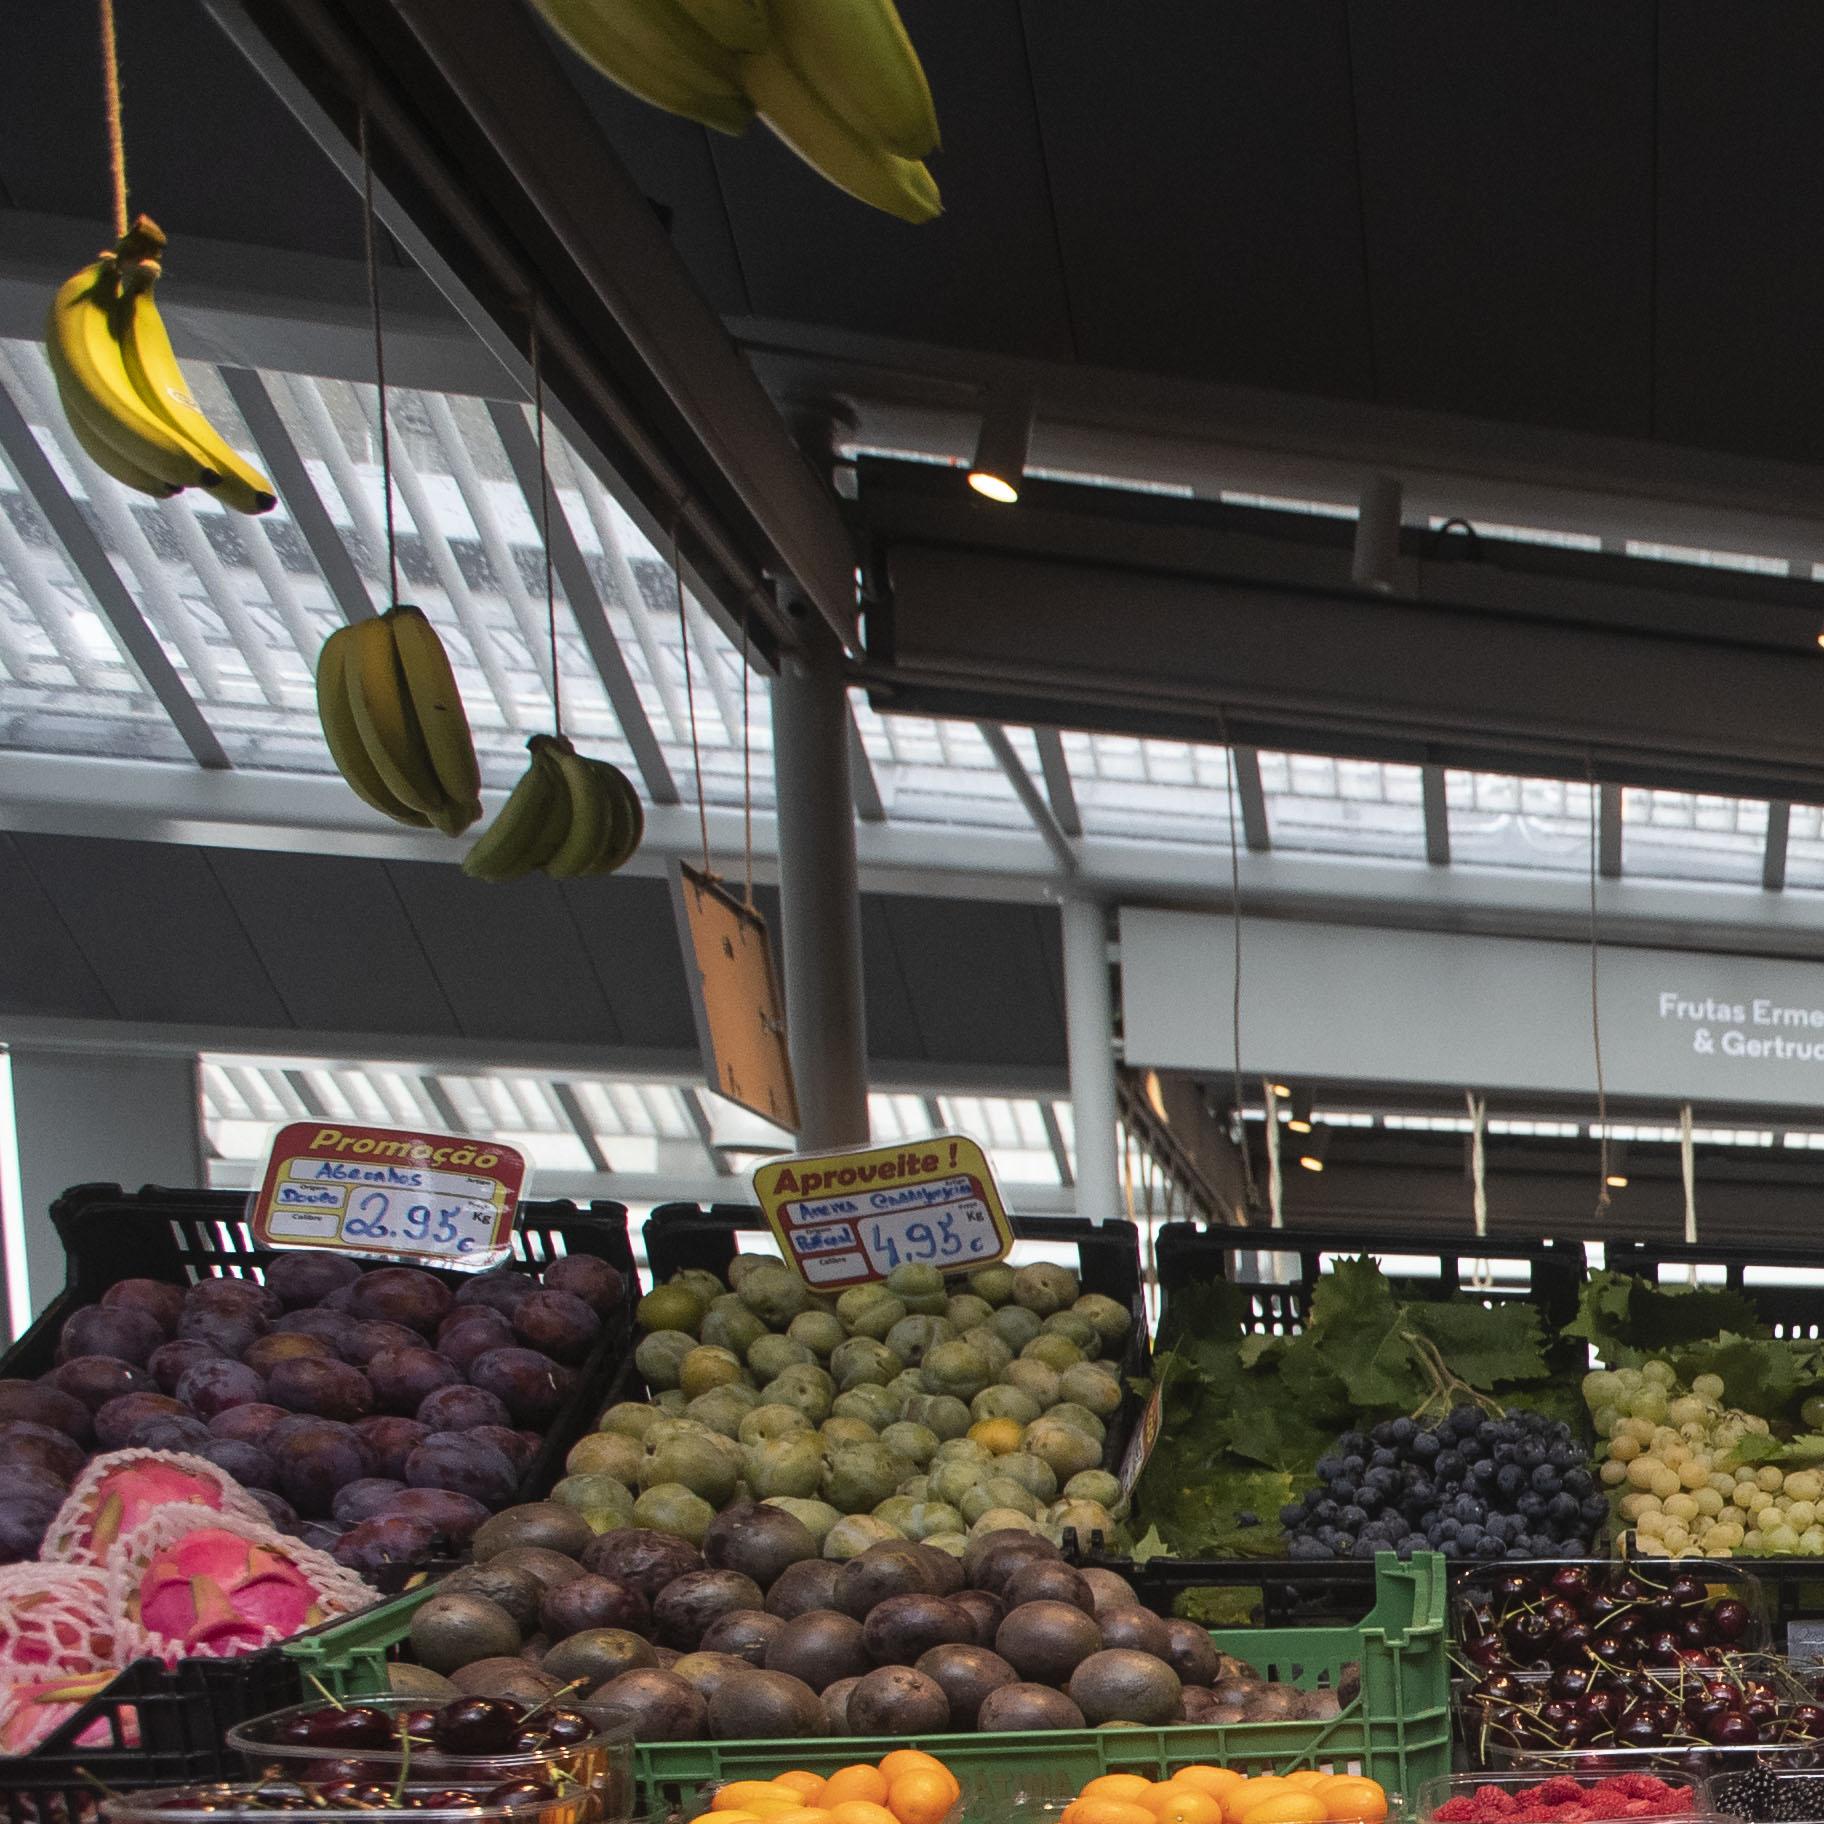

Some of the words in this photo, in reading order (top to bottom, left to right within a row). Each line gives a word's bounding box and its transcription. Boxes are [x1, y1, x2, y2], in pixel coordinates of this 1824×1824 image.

[1659, 992, 1746, 1024] Frutas
[1693, 1028, 1715, 1055] &
[309, 1129, 499, 1169] Promoção
[773, 1152, 939, 1196] Aproveite
[472, 1211, 491, 1225] Kg
[967, 1211, 985, 1222] Kg
